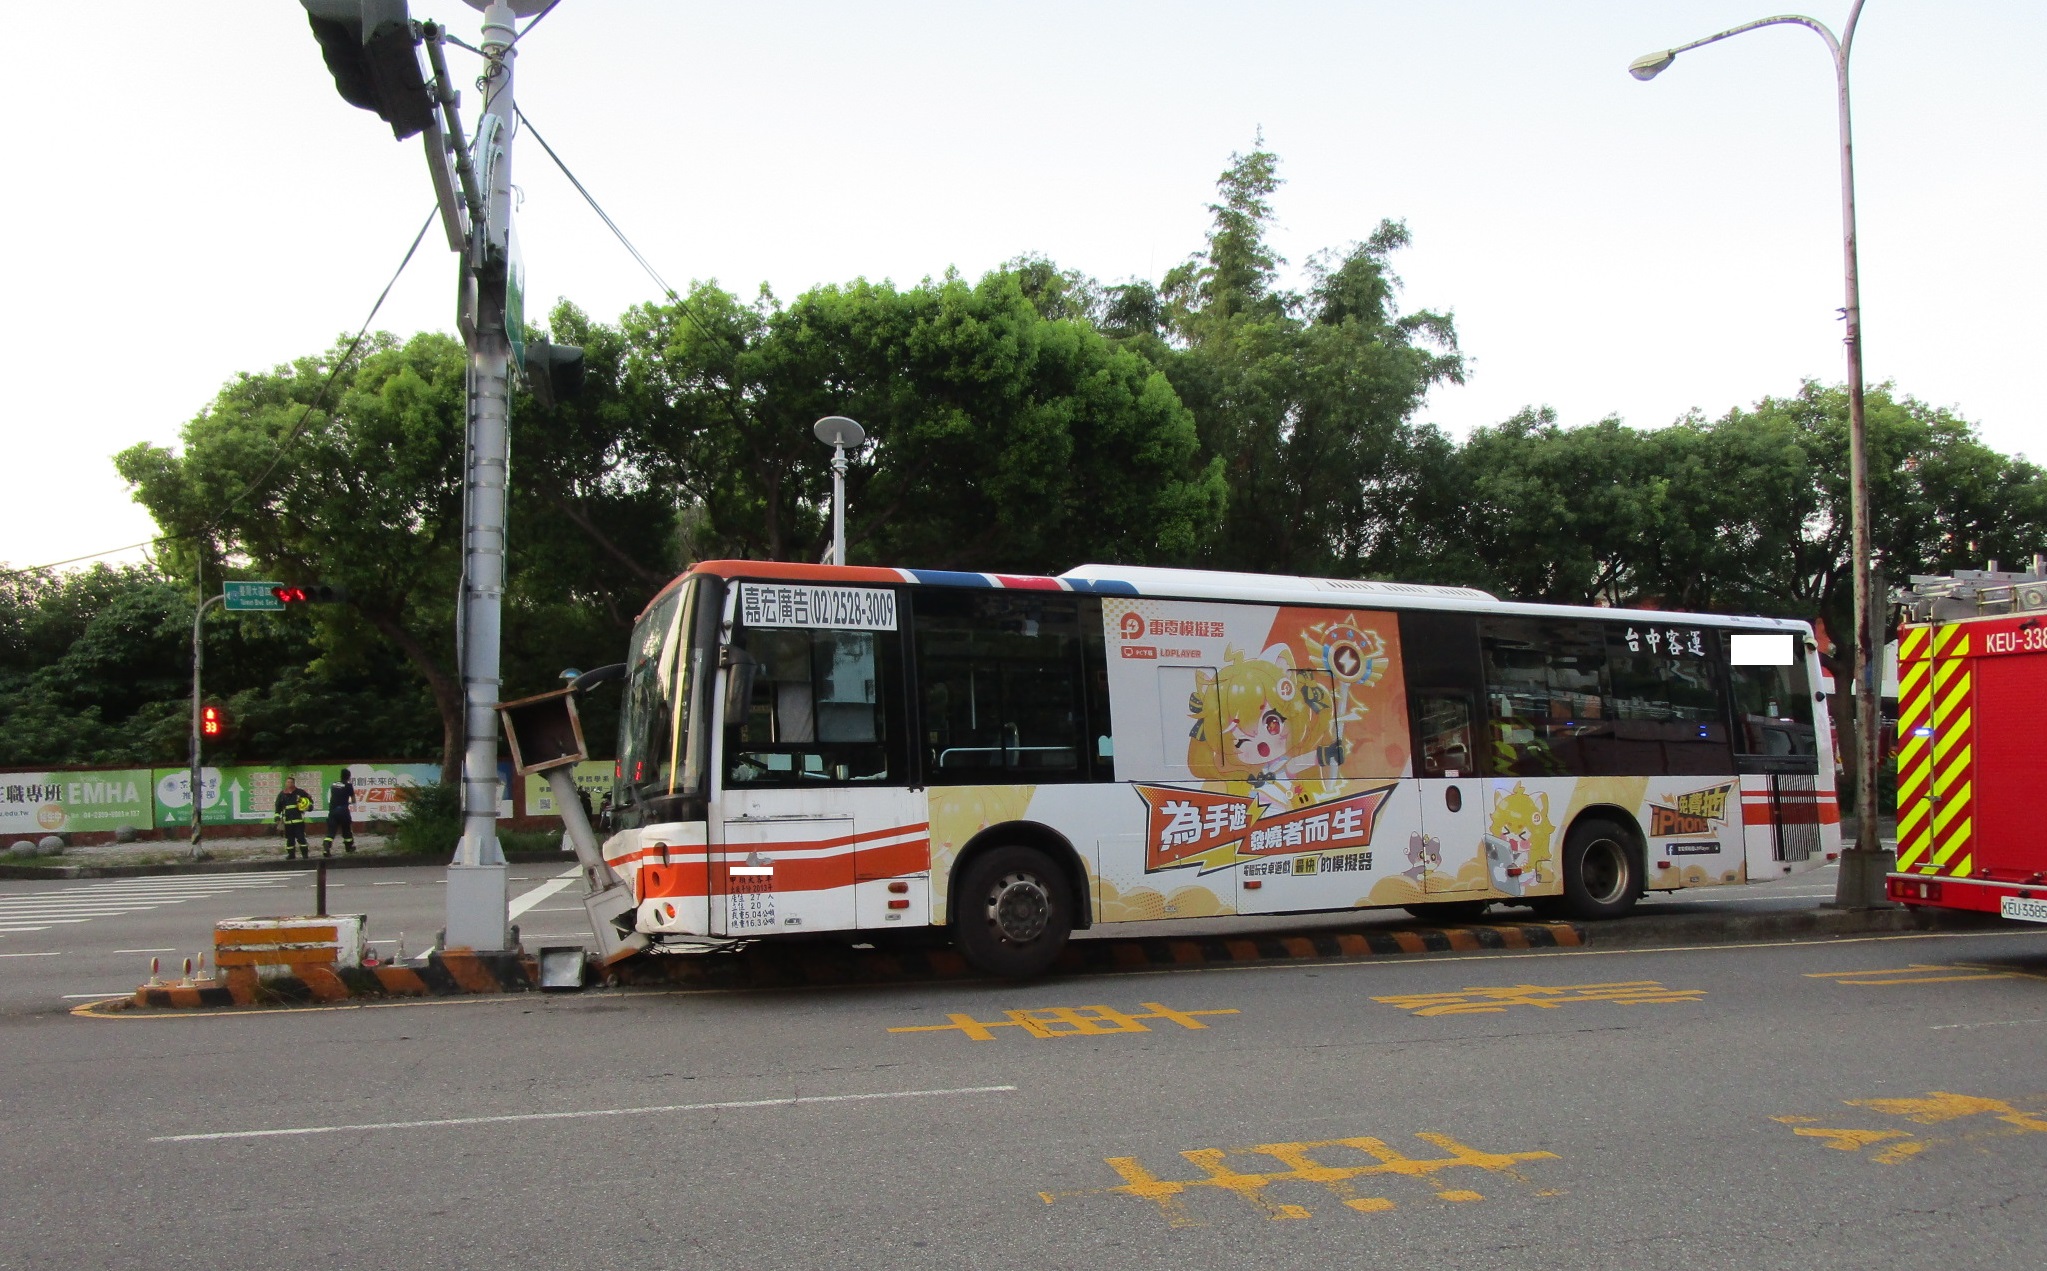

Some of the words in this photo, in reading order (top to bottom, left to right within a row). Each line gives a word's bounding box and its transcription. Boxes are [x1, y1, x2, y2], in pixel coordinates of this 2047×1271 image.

[1149, 619, 1224, 638] 雷電模擬器
[1624, 627, 1705, 657] 台中客運
[1160, 648, 1202, 659] LDPLAYER
[205, 721, 217, 733] 33
[67, 782, 140, 805] EMHA
[1679, 787, 1728, 820] 免費抽
[1159, 800, 1247, 852] 為手遊
[1250, 807, 1364, 852] 發燒者而生
[1651, 806, 1709, 836] iPhone
